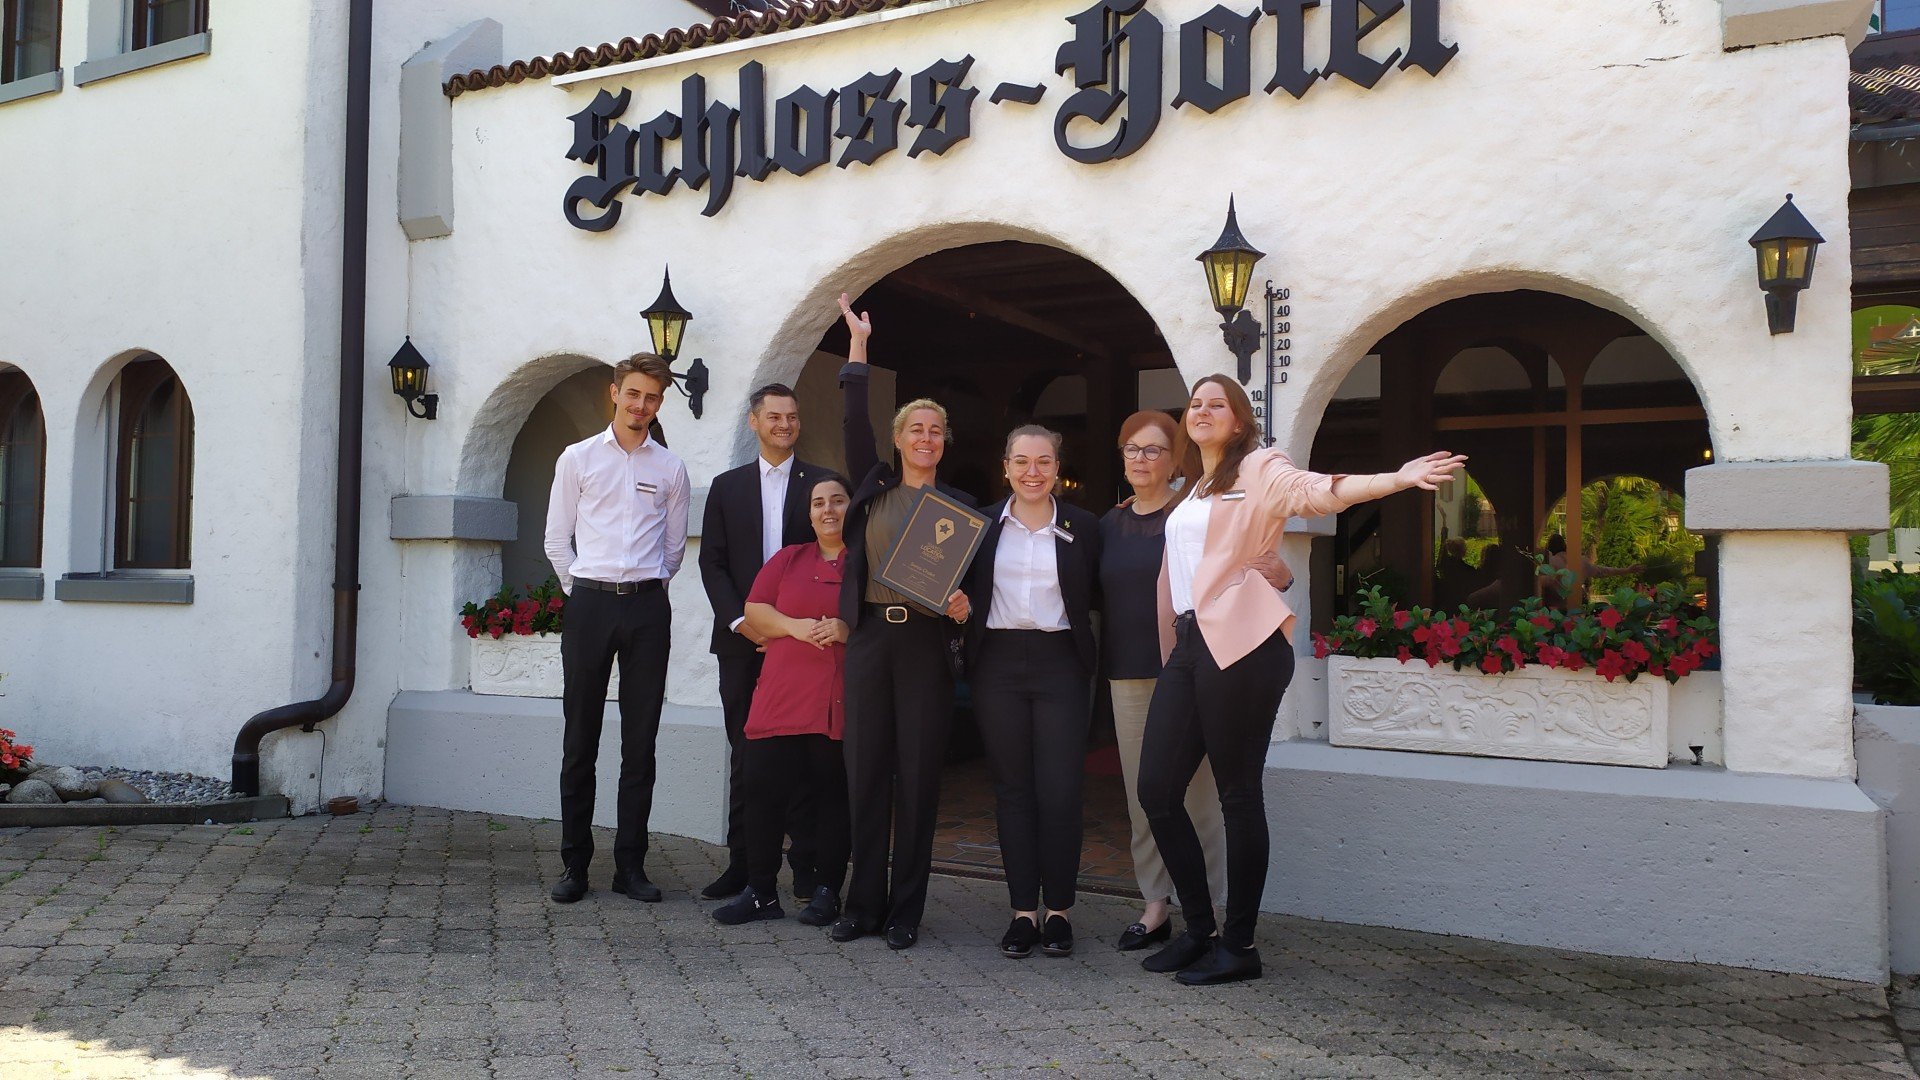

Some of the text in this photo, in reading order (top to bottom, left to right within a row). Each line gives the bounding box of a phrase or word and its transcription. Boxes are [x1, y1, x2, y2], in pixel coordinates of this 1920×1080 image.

[1276, 288, 1290, 300] 50
[1276, 305, 1290, 317] 40
[1277, 322, 1291, 333] 30
[1277, 338, 1291, 350] 20
[1278, 355, 1291, 366] 10
[1280, 372, 1288, 383] 0
[1251, 390, 1262, 401] 10
